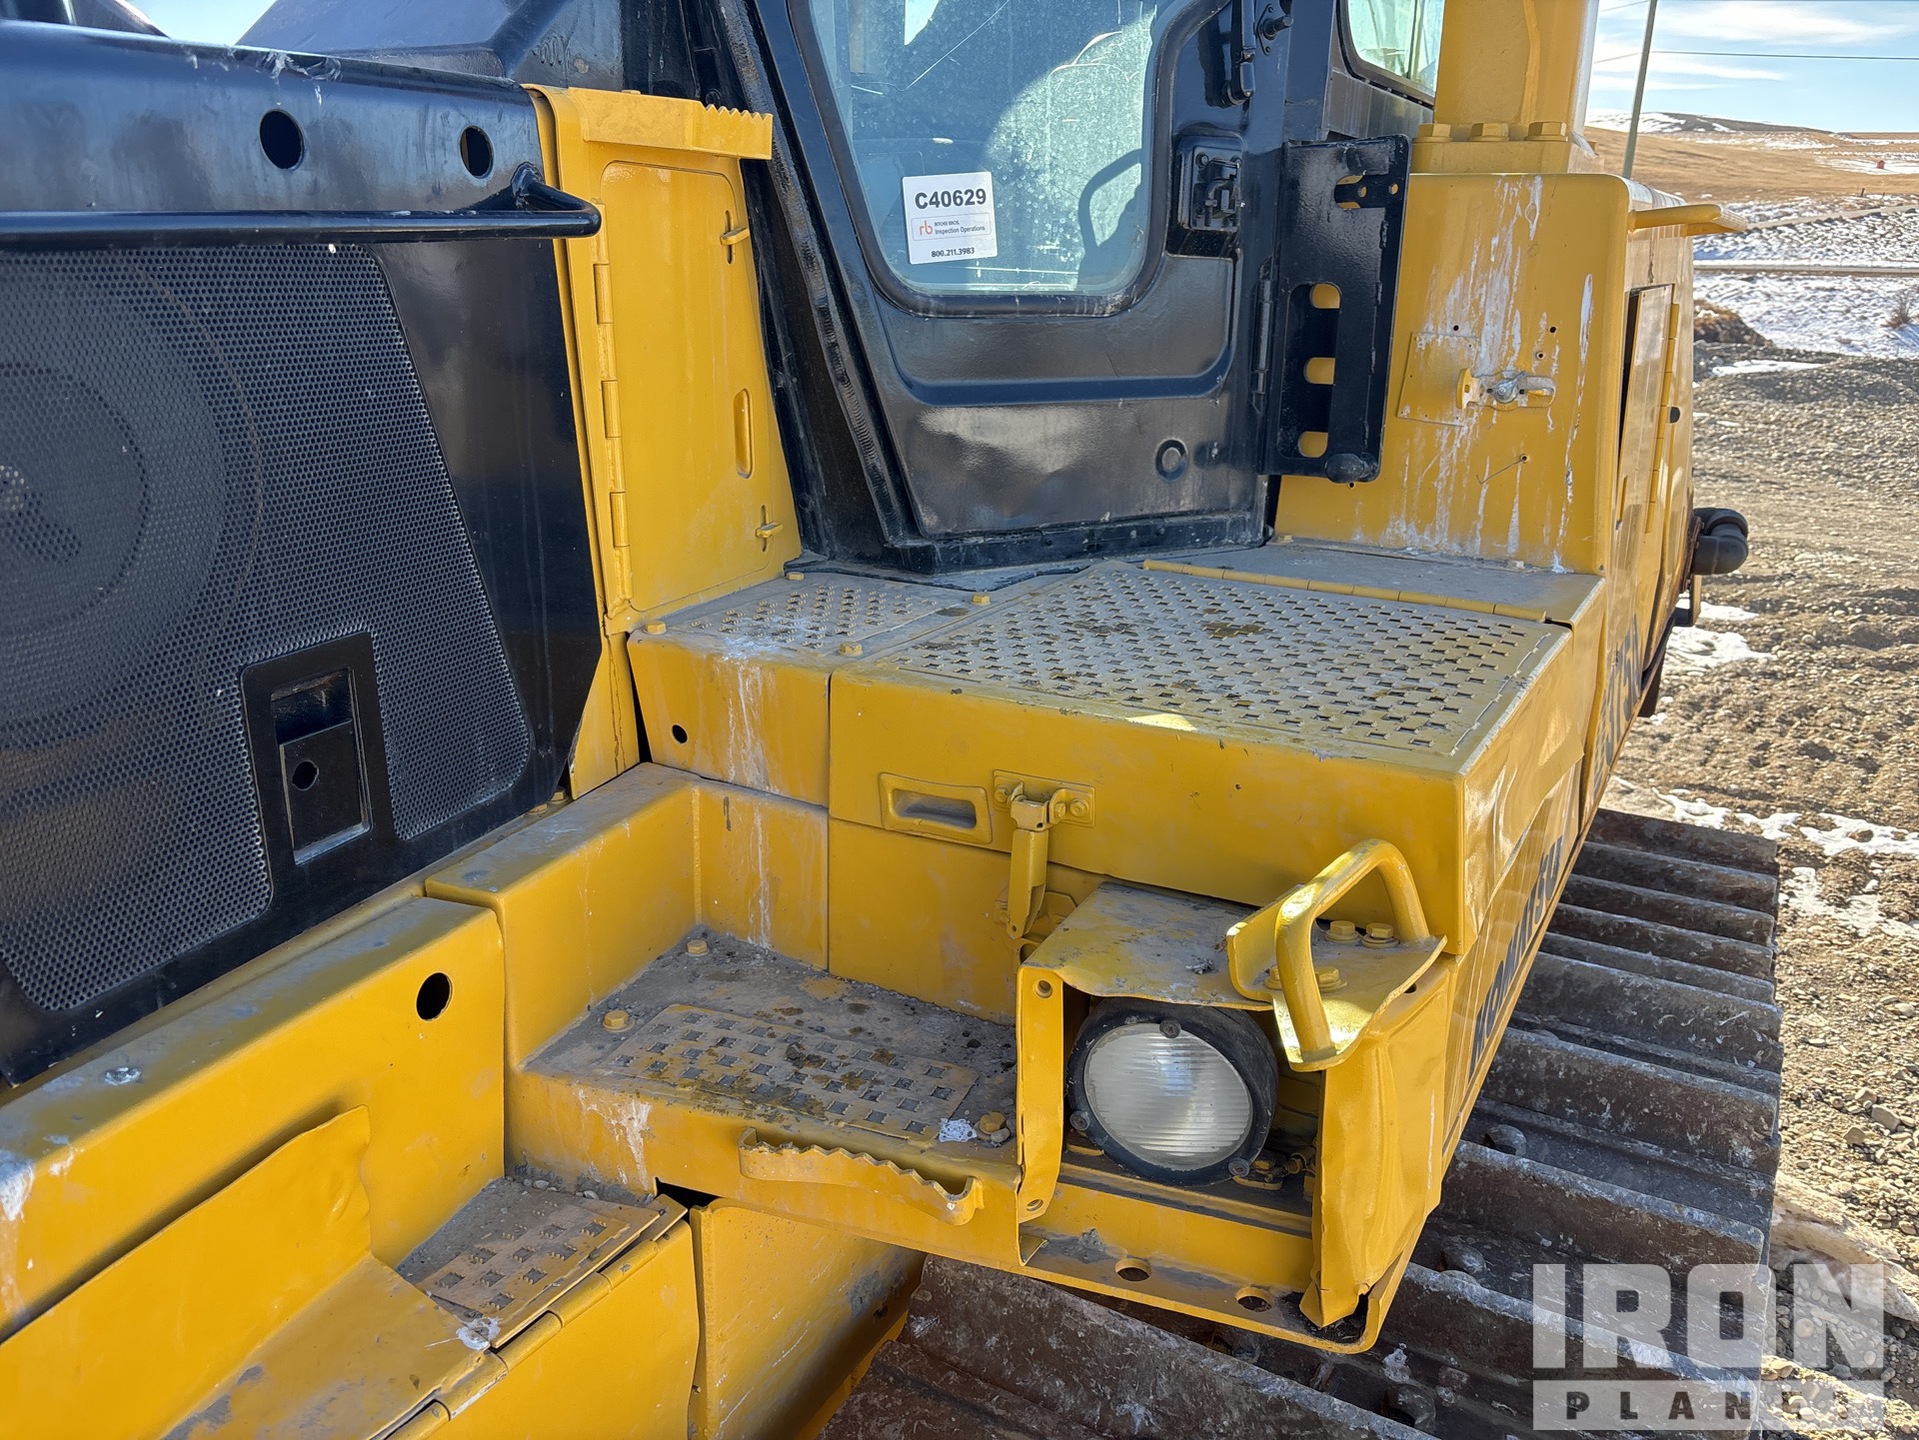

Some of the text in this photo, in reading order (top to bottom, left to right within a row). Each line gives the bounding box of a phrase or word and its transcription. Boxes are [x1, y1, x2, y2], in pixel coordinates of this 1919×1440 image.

[914, 188, 987, 209] C40629
[919, 220, 933, 236] rb
[931, 247, 975, 257] 800.211.3983
[1469, 834, 1564, 1083] KOMATSU
